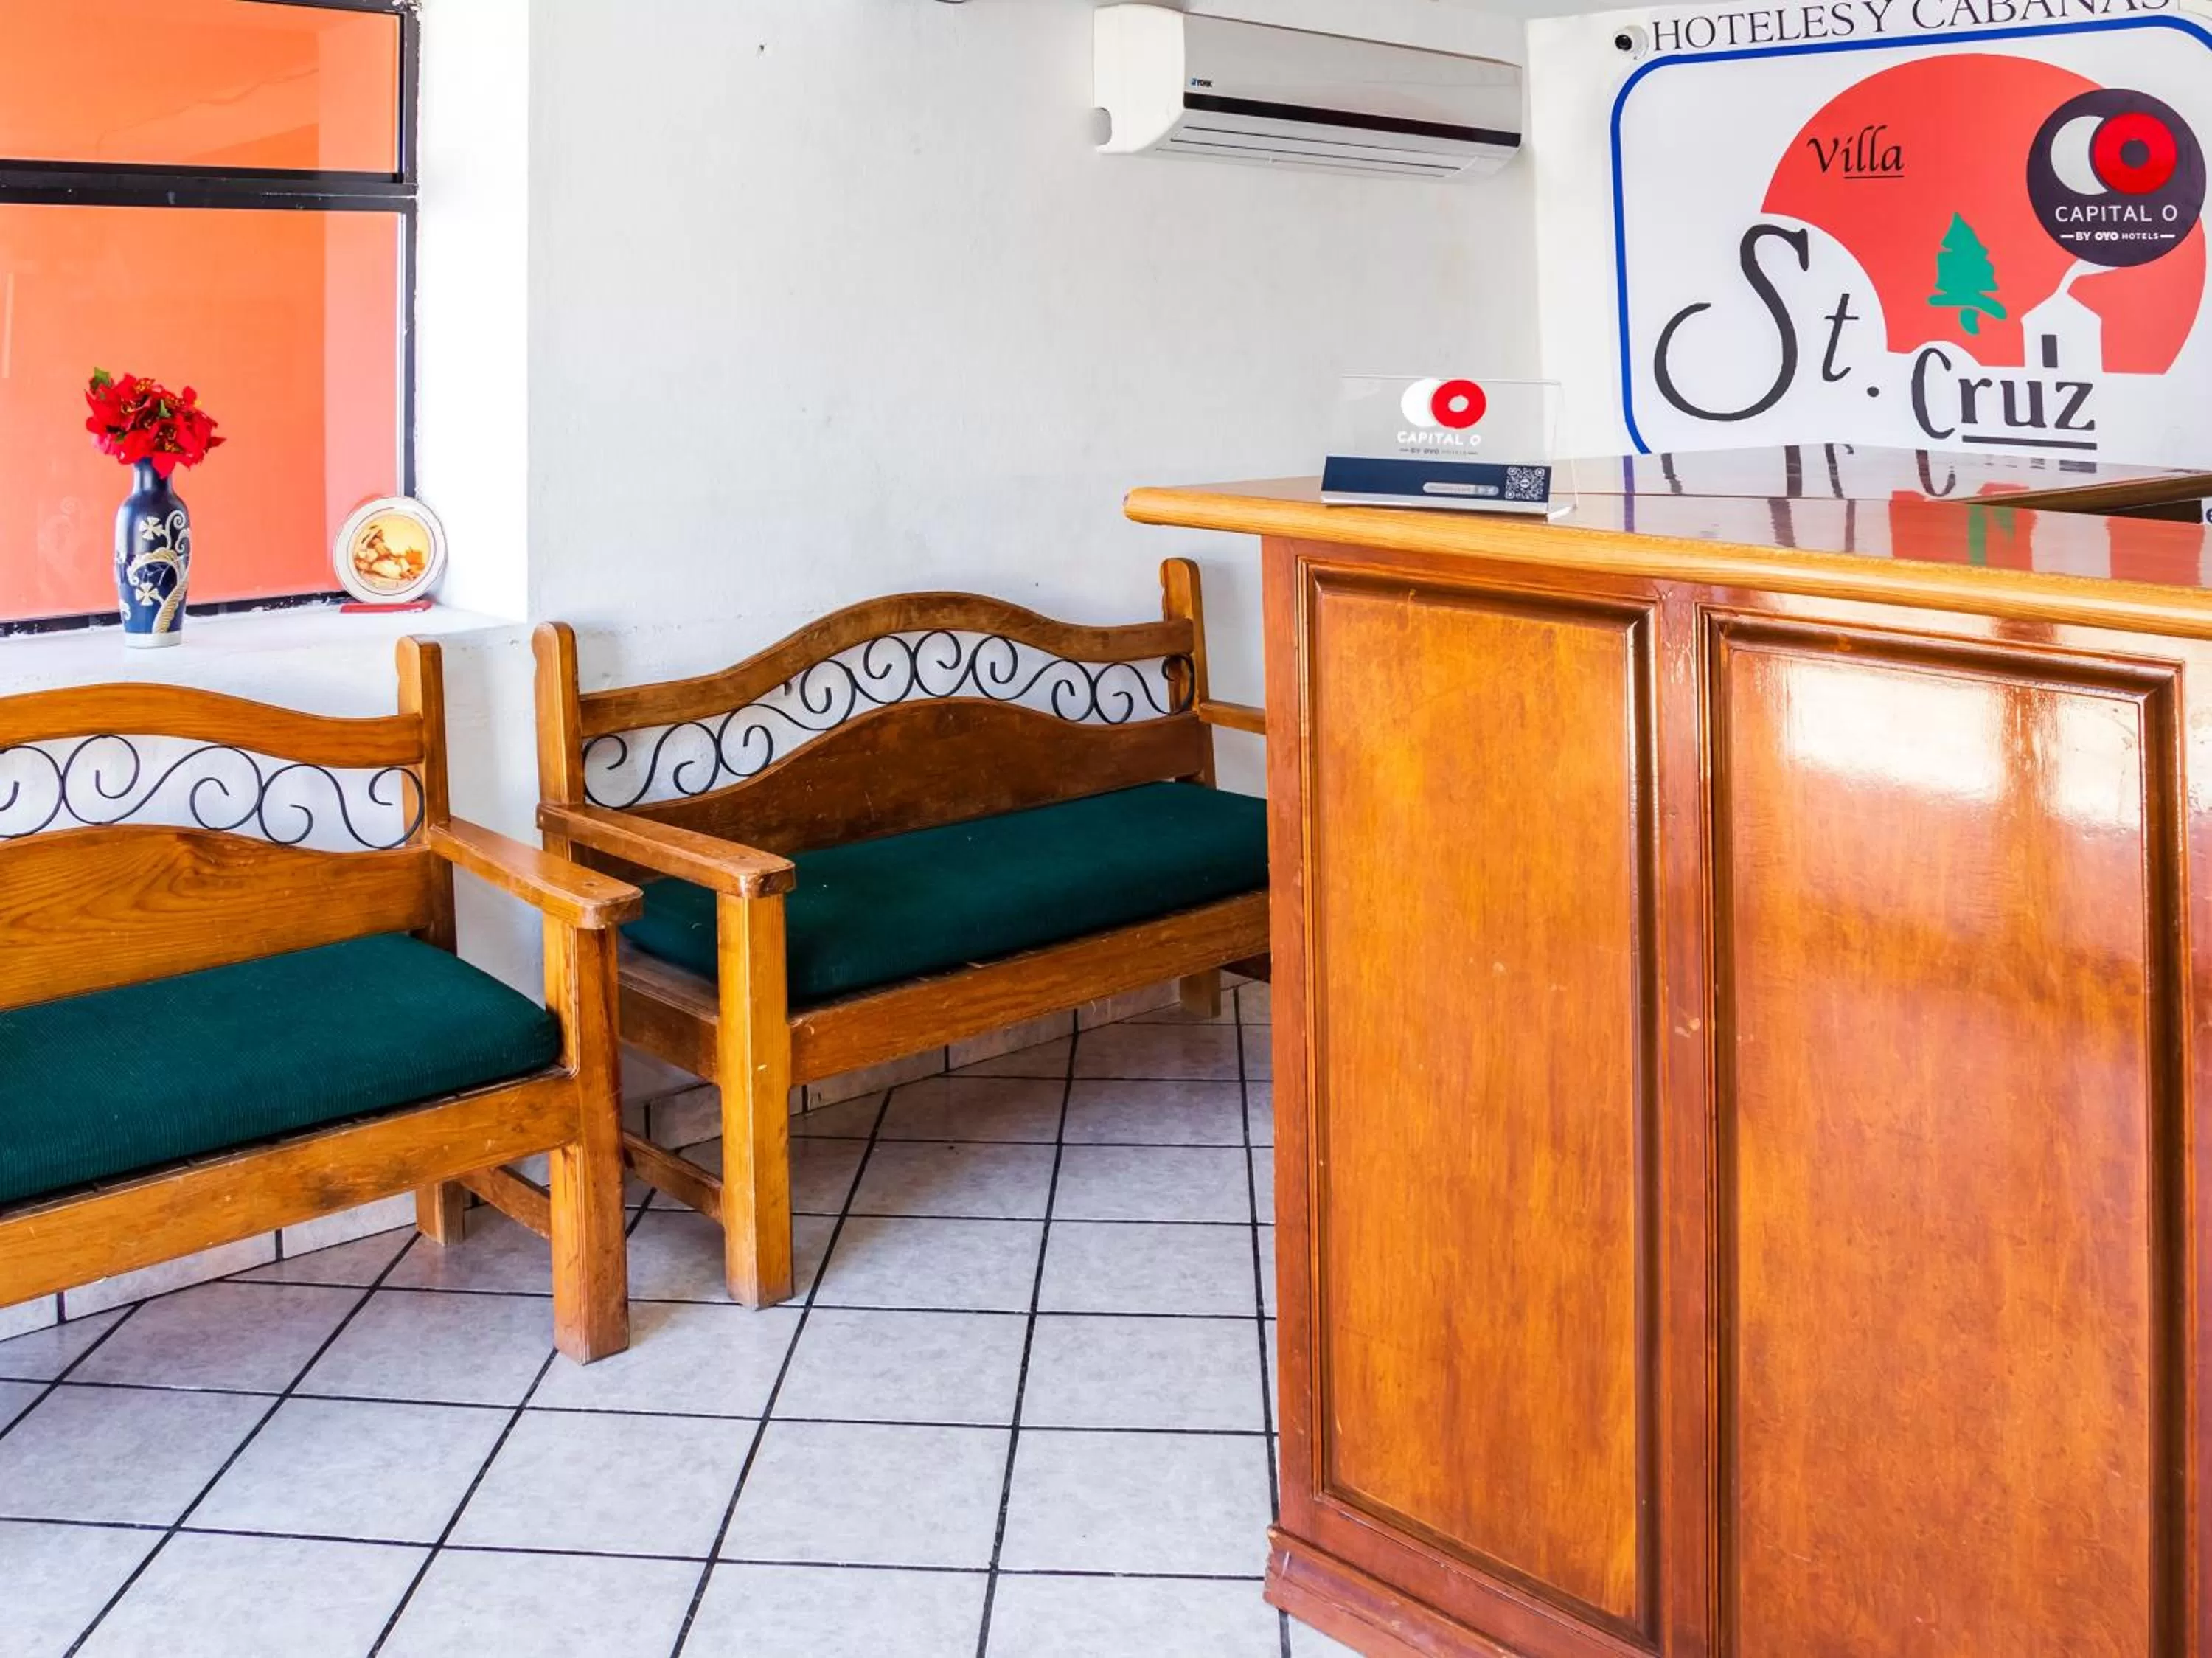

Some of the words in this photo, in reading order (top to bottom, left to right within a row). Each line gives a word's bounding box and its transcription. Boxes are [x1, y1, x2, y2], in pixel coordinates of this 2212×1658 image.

[1652, 1, 1855, 52] HOTELES
[1806, 124, 1905, 173] Villa
[2054, 205, 2152, 222] CAPITAL
[2161, 204, 2178, 222] O
[2075, 231, 2091, 241] BY
[2094, 231, 2119, 241] OYO
[1654, 223, 1880, 422] St.
[1910, 347, 2096, 440] Cruz
[1397, 430, 1464, 446] CAPITAL
[1470, 434, 1481, 446] O
